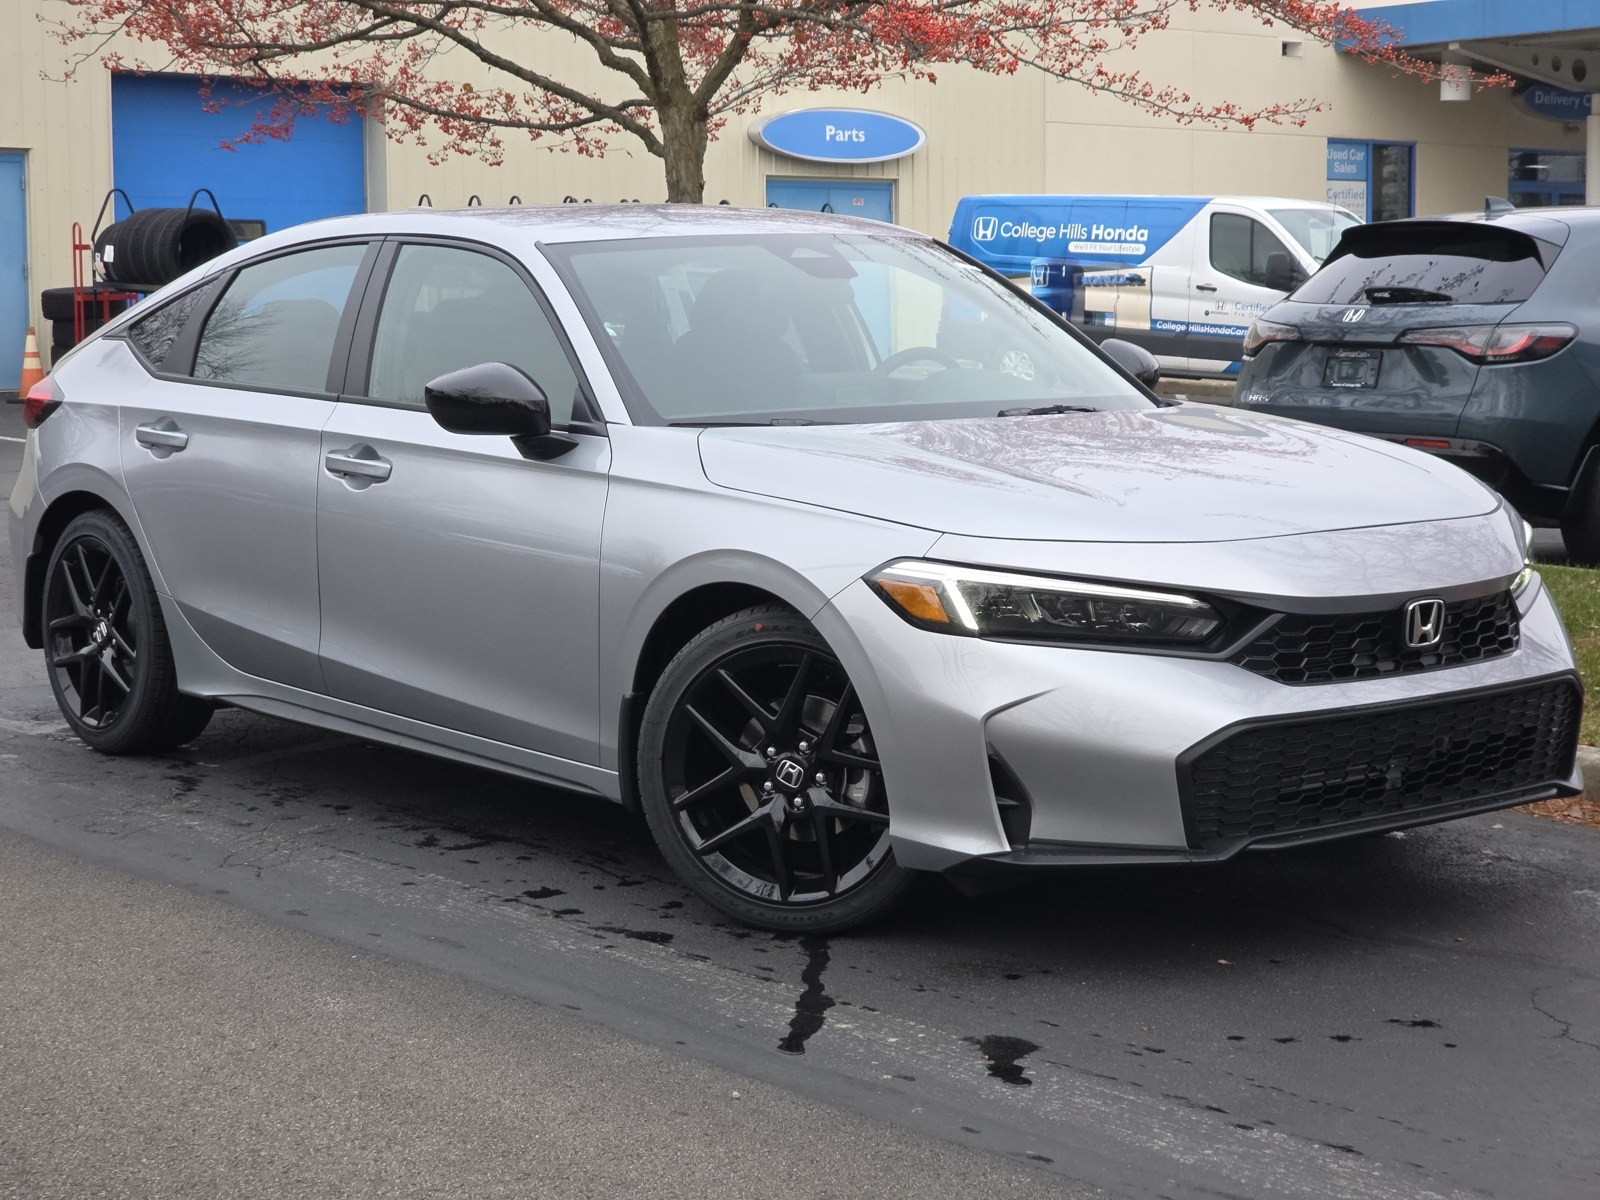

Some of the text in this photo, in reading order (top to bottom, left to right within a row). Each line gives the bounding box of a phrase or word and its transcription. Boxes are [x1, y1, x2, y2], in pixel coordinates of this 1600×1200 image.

[1535, 90, 1580, 110] Delivery
[825, 125, 865, 142] Parts
[1327, 148, 1365, 160] Used Car
[1334, 161, 1357, 173] Sales
[1326, 187, 1365, 200] Certified
[1000, 222, 1149, 242] College Hills Honda
[1113, 244, 1141, 253] Lifestyle
[1156, 321, 1187, 333] College
[1248, 394, 1274, 402] HR-V
